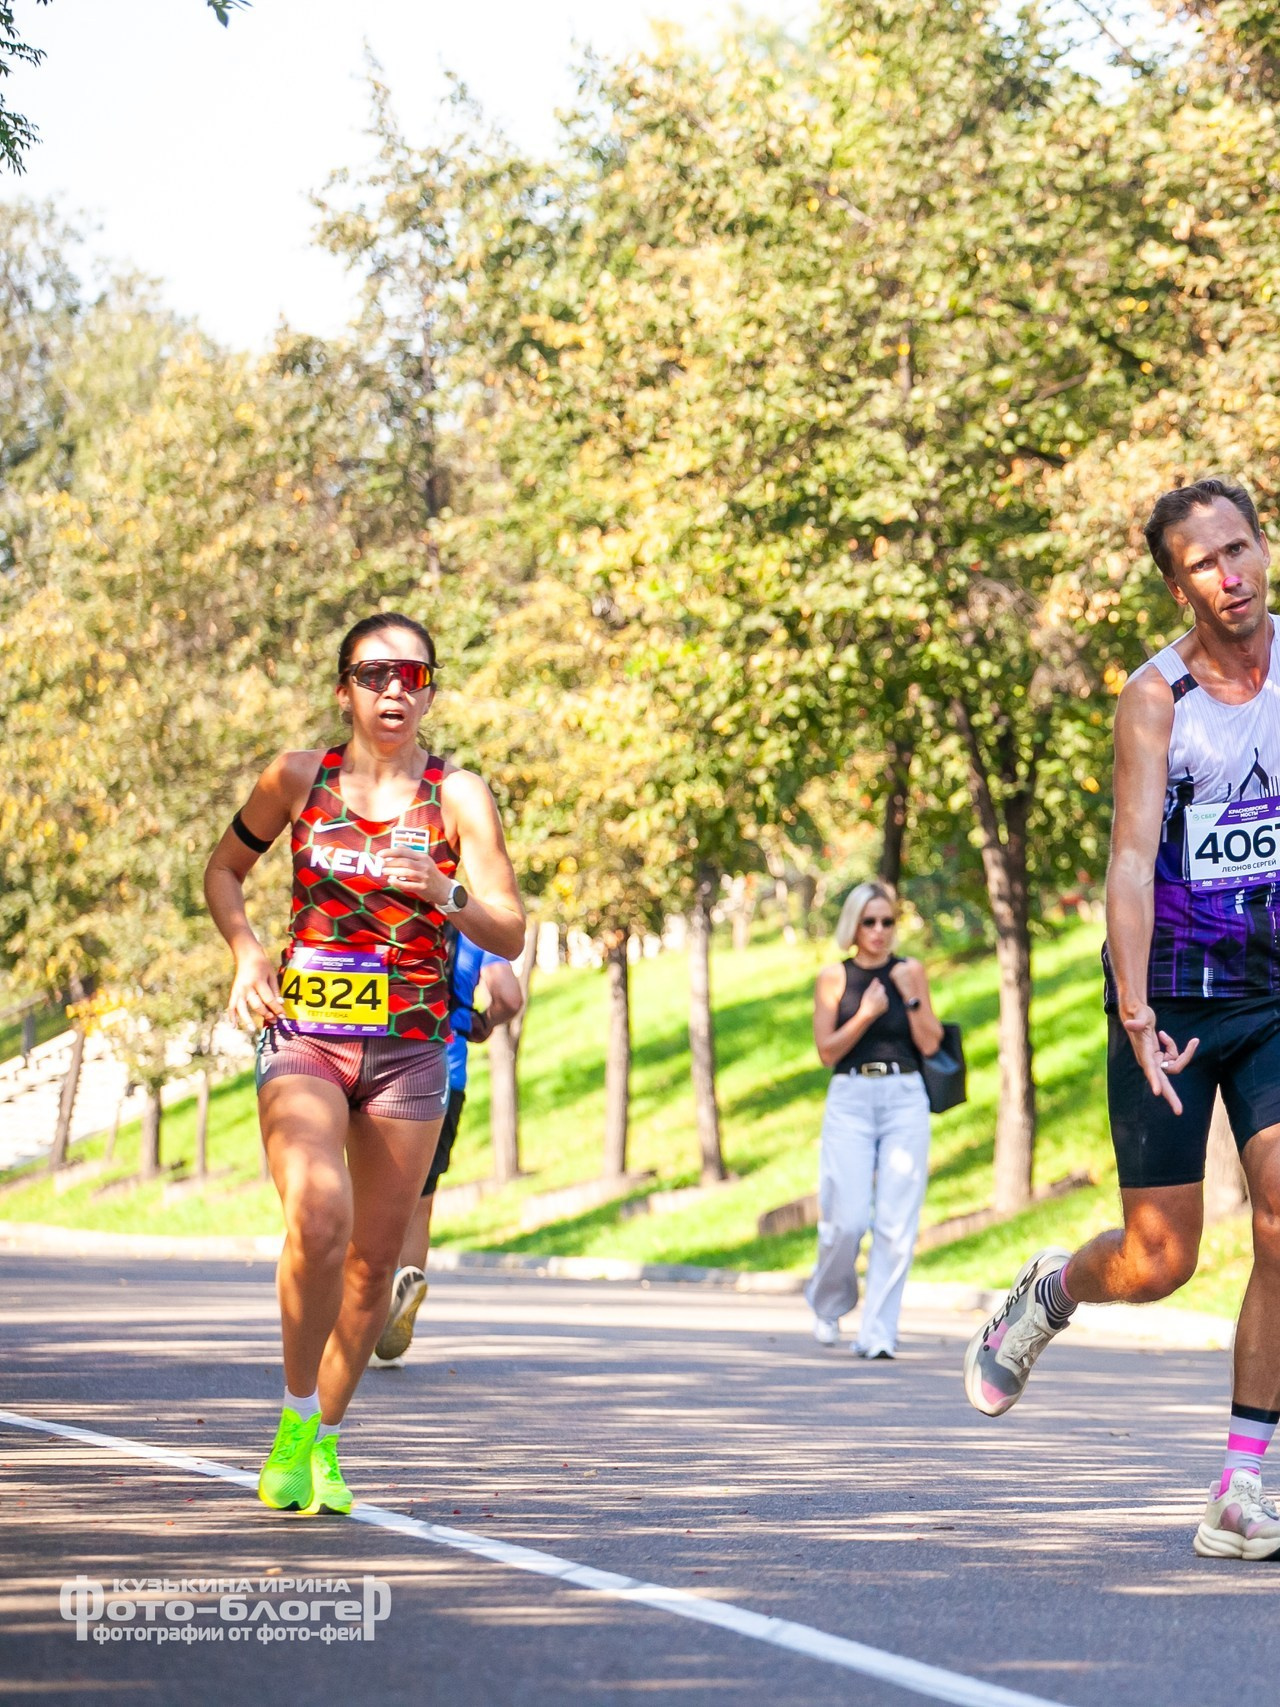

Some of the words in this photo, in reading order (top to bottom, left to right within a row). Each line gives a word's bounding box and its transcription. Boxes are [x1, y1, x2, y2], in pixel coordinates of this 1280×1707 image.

[310, 845, 385, 877] KEN
[1222, 863, 1252, 873] ЛЕОНОВ
[1252, 859, 1277, 869] СЕРГЕЙ
[283, 975, 382, 1010] 4324
